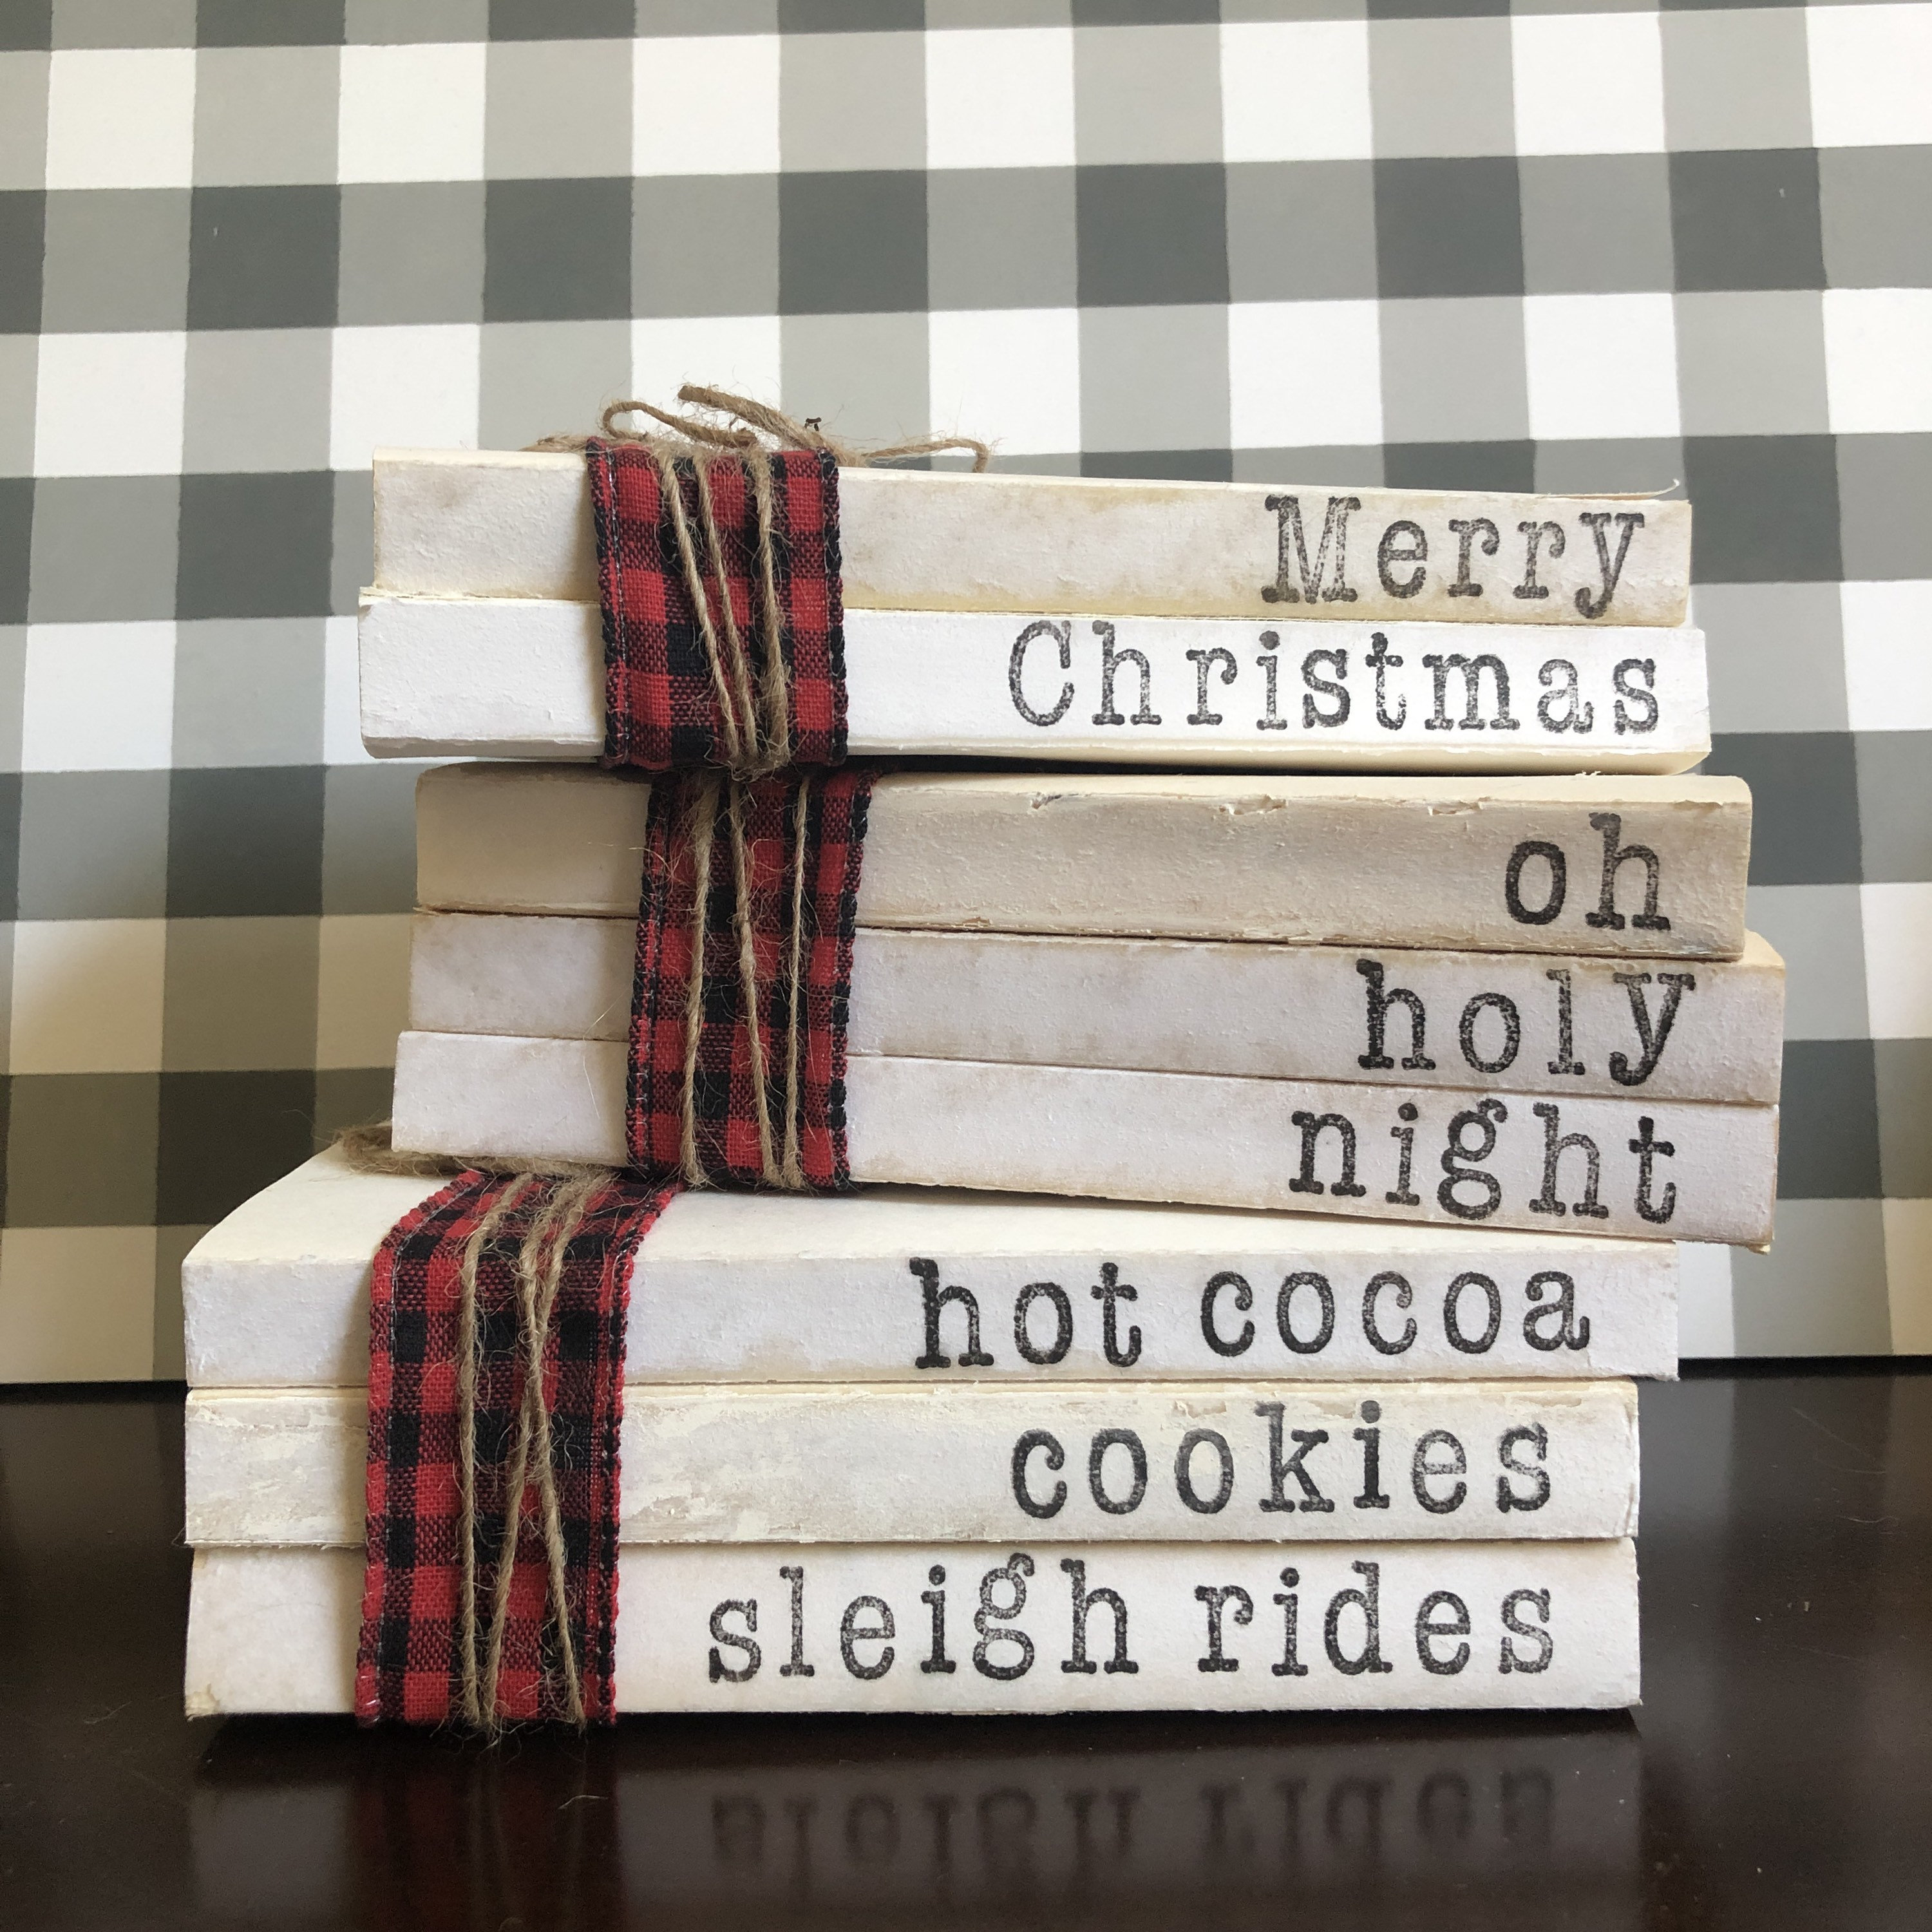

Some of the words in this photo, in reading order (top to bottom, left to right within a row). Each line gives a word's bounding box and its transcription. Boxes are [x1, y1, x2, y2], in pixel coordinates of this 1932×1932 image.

[1262, 493, 1645, 620] Merry
[1009, 620, 1657, 734] Christmas
[1504, 811, 1672, 932] oh
[1355, 958, 1697, 1087] holy
[1288, 1097, 1676, 1225] night
[909, 1257, 1142, 1370] hot
[1200, 1271, 1591, 1358] cocoa
[1012, 1400, 1551, 1520] cookies
[708, 1551, 1139, 1684] sleigh
[1194, 1560, 1553, 1677] rides
